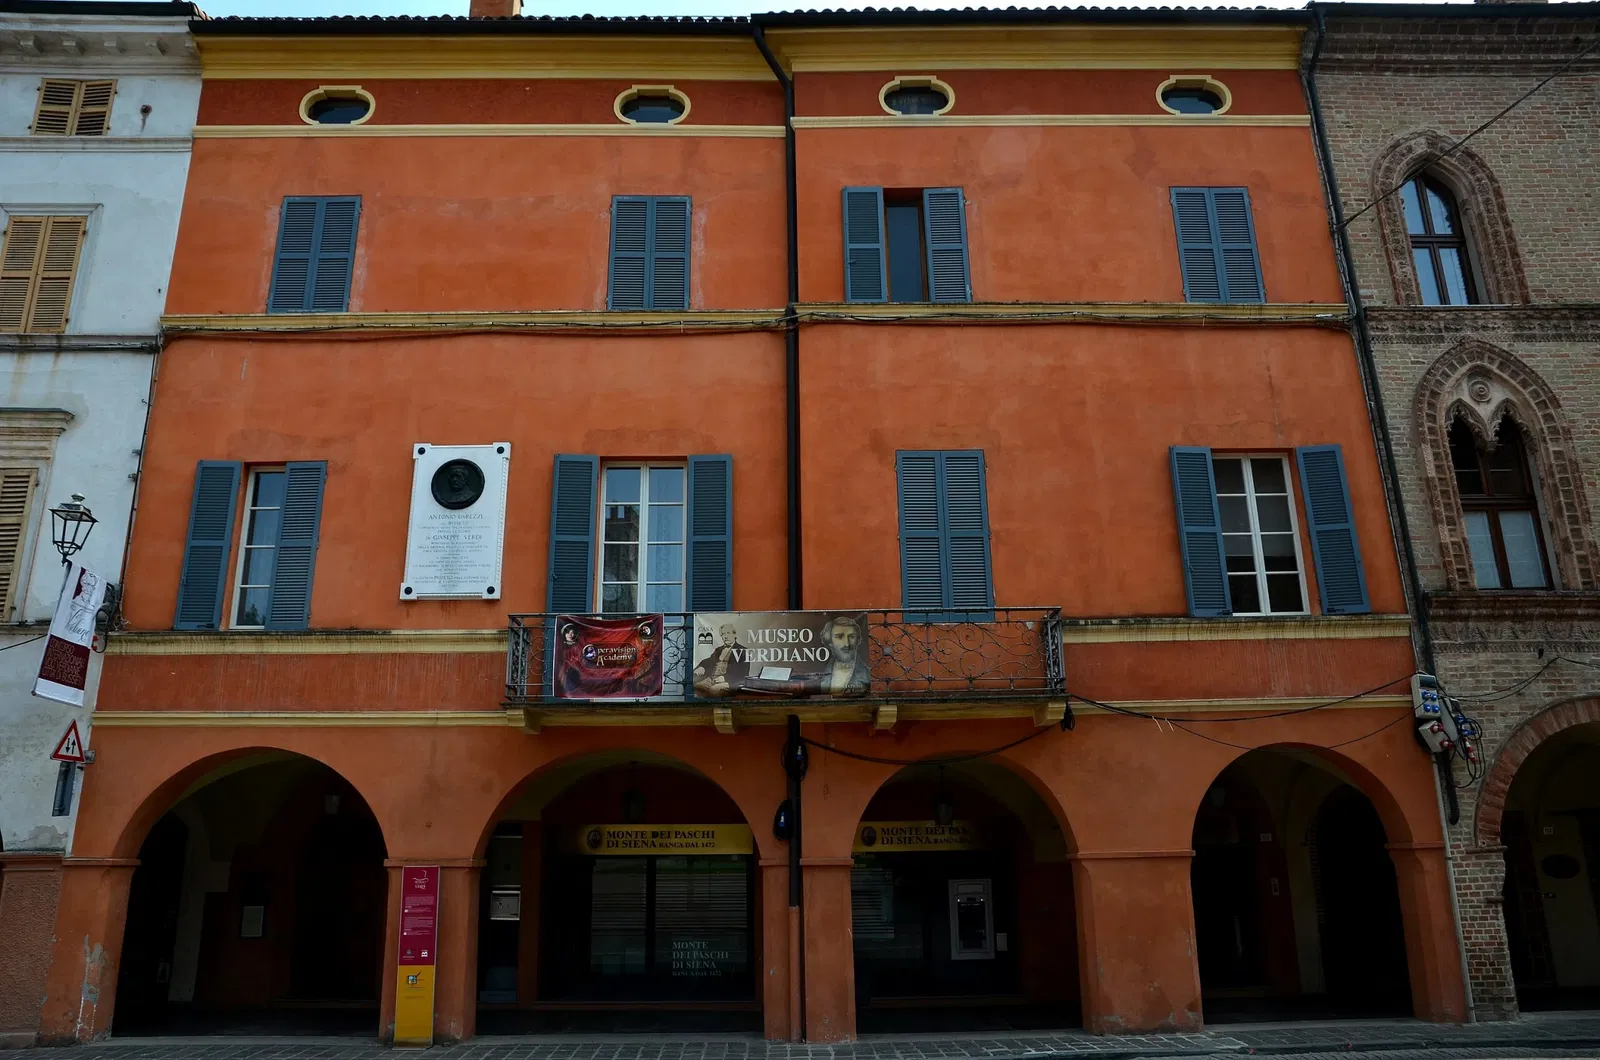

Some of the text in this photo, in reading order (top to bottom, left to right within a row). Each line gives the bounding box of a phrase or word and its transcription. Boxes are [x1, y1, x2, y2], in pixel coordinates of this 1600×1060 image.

[747, 628, 814, 644] MUSEO
[731, 647, 830, 663] VERDIANO
[606, 830, 715, 839] MONTE DEI PASCHI
[880, 827, 919, 836] MONTE
[925, 826, 945, 835] DEI
[606, 840, 619, 848] DI
[622, 840, 657, 848] SIENA
[896, 836, 931, 844] SIENA
